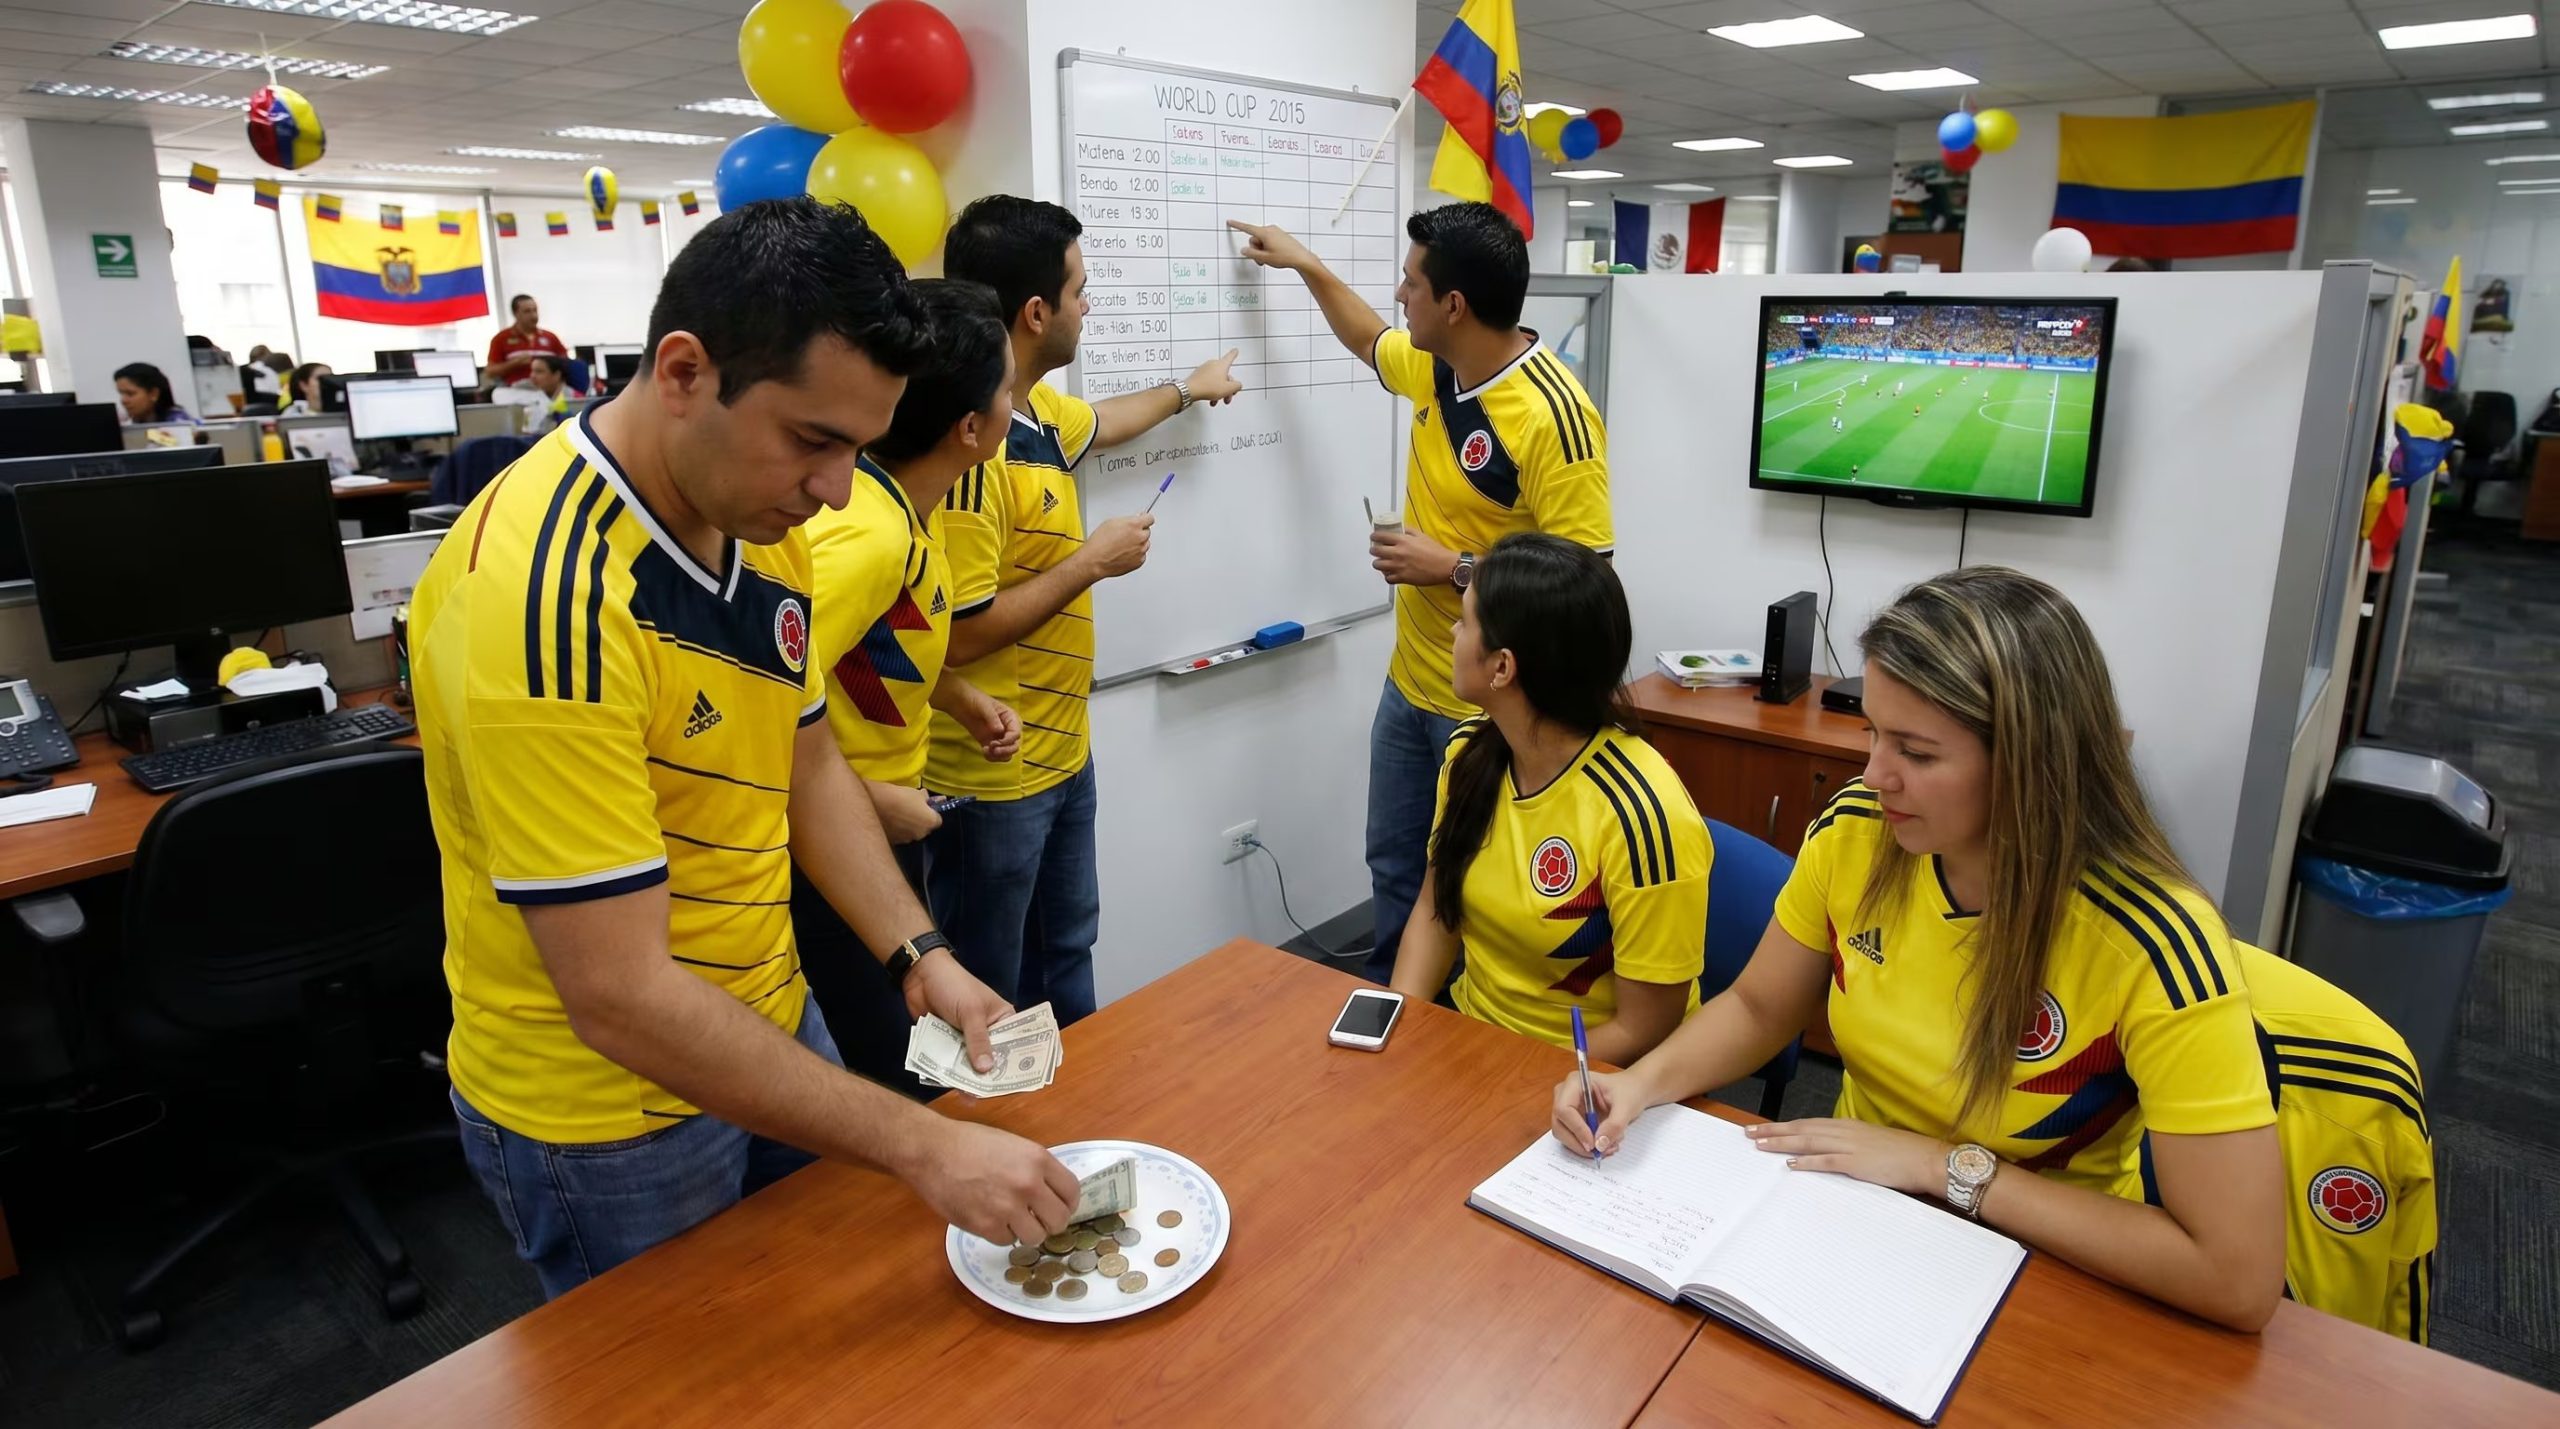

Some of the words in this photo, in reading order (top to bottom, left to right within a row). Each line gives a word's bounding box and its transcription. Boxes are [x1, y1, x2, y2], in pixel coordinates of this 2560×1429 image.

[1154, 84, 1216, 115] WORLD
[1226, 92, 1257, 119] CUP
[1268, 99, 1305, 125] 2015
[1080, 173, 1118, 192] Bendo
[683, 710, 723, 739] adidas
